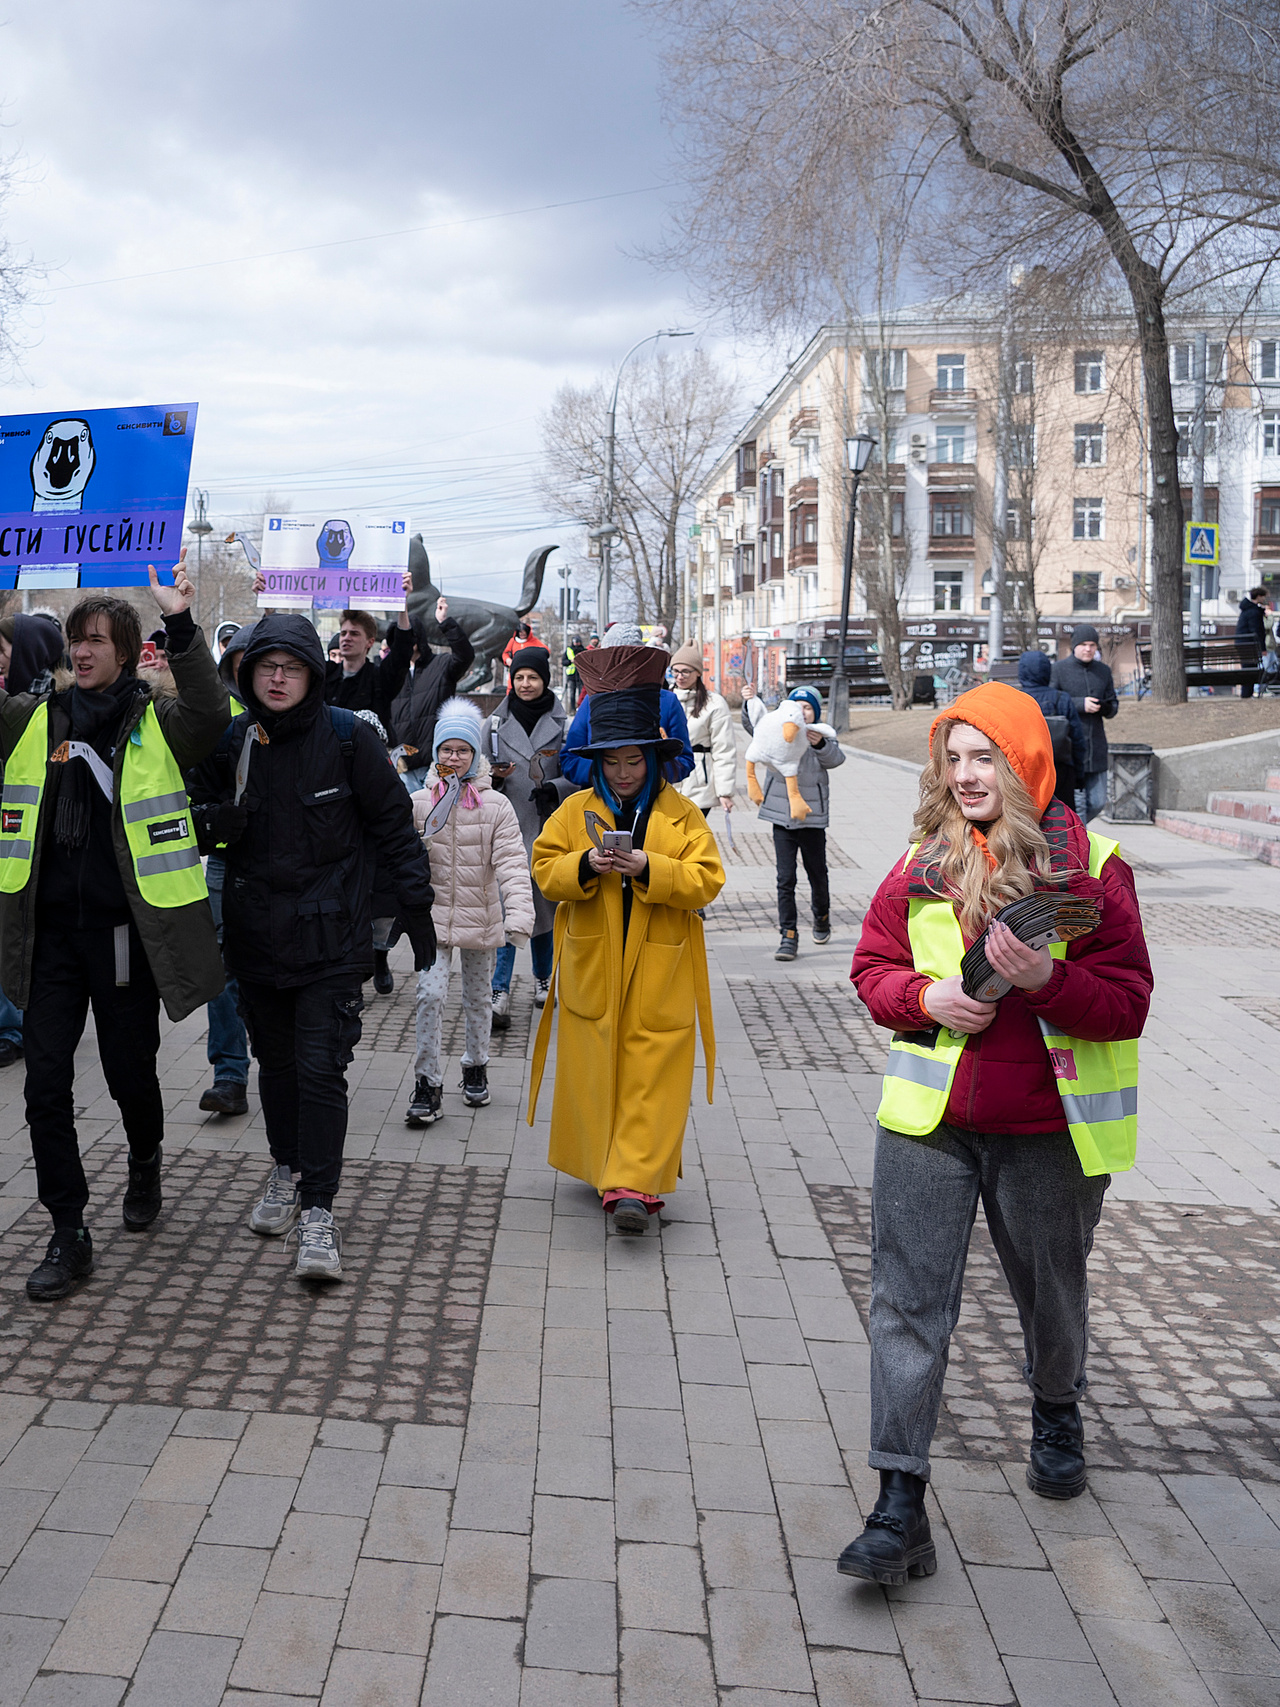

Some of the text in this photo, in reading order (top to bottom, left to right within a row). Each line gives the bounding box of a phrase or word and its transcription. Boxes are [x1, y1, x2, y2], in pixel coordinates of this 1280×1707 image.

[116, 421, 163, 430] СЕНСИВИТИ
[63, 518, 167, 555] ГУСЕЙ!!!
[268, 574, 398, 593] ОТПУСТИ ГУСЕЙ!!!
[906, 623, 937, 636] TELE2
